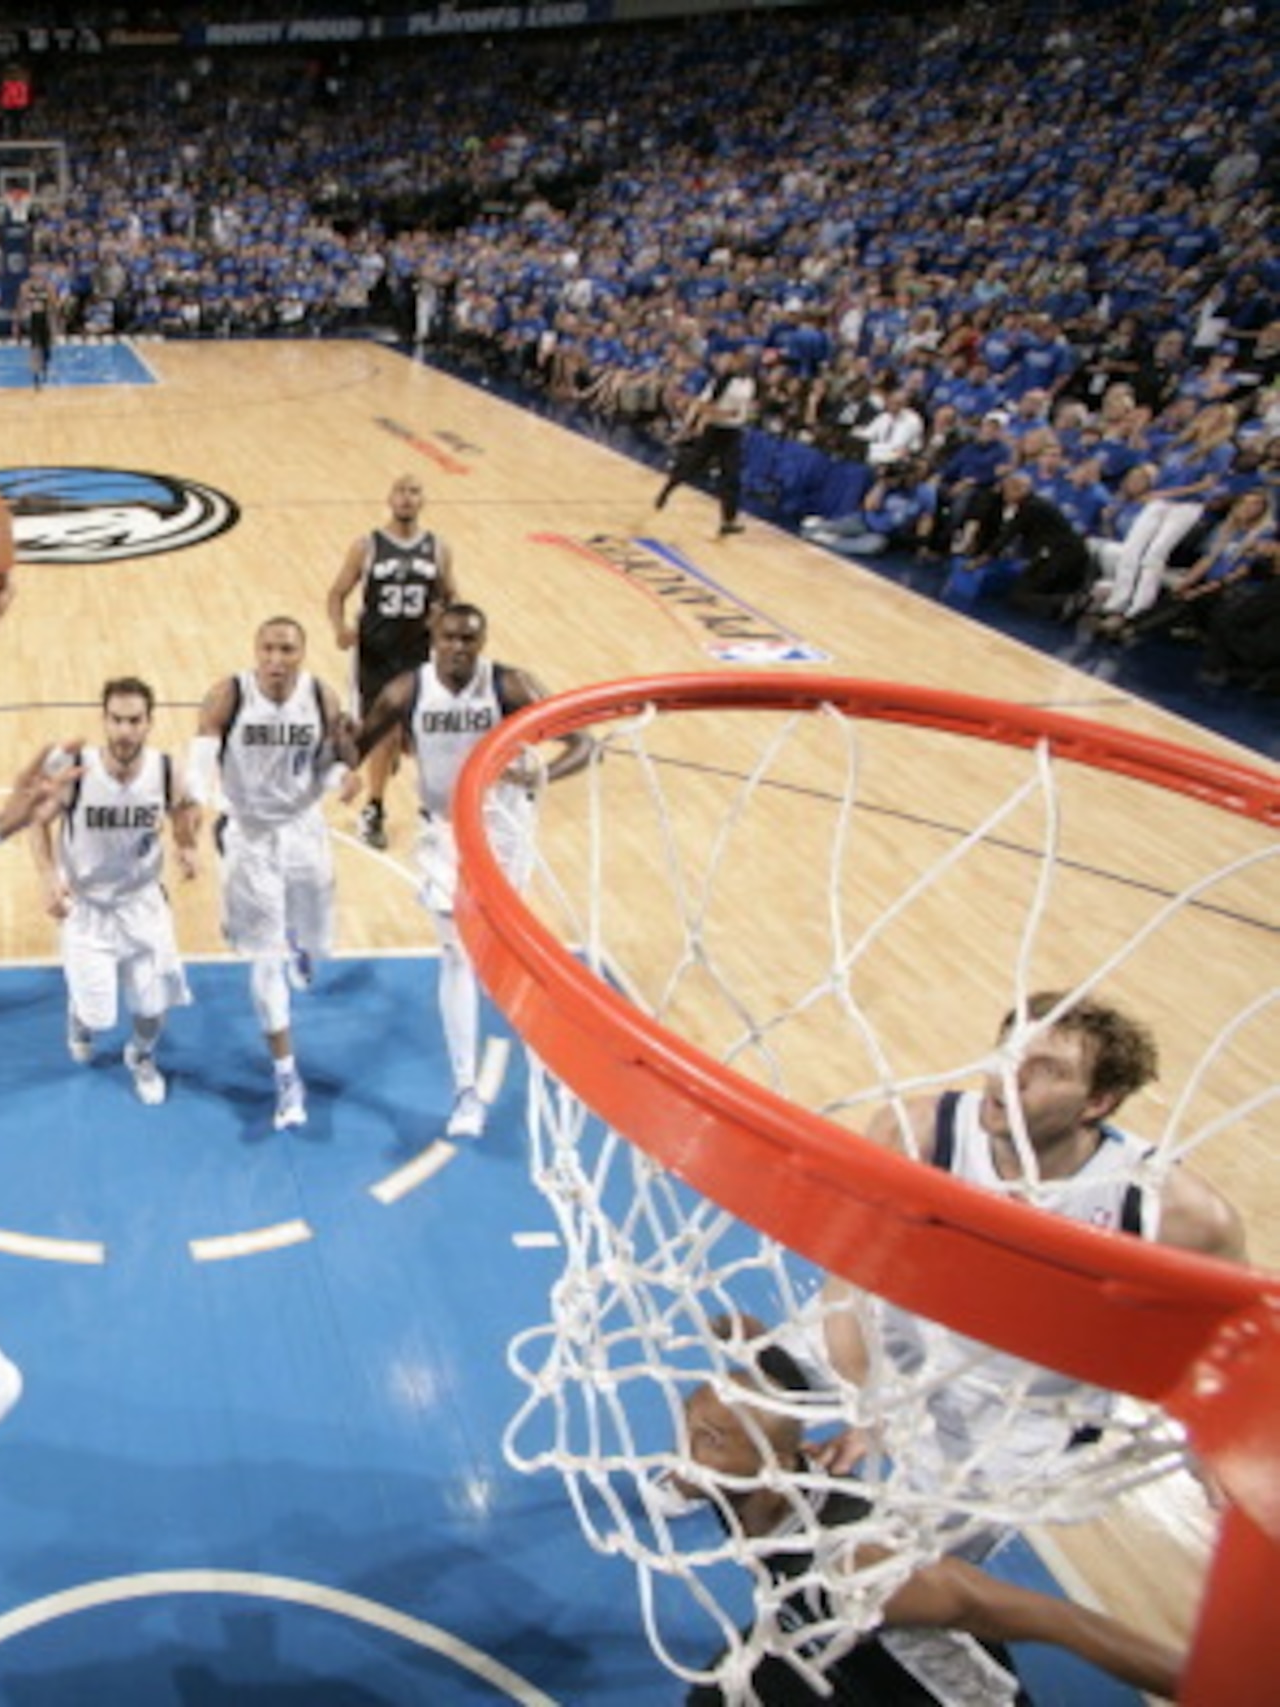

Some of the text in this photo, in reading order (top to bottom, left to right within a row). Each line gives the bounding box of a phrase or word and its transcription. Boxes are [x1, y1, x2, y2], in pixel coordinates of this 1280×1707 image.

[377, 583, 428, 618] 33
[242, 723, 315, 746] DALLAS
[84, 804, 159, 829] DALLAS
